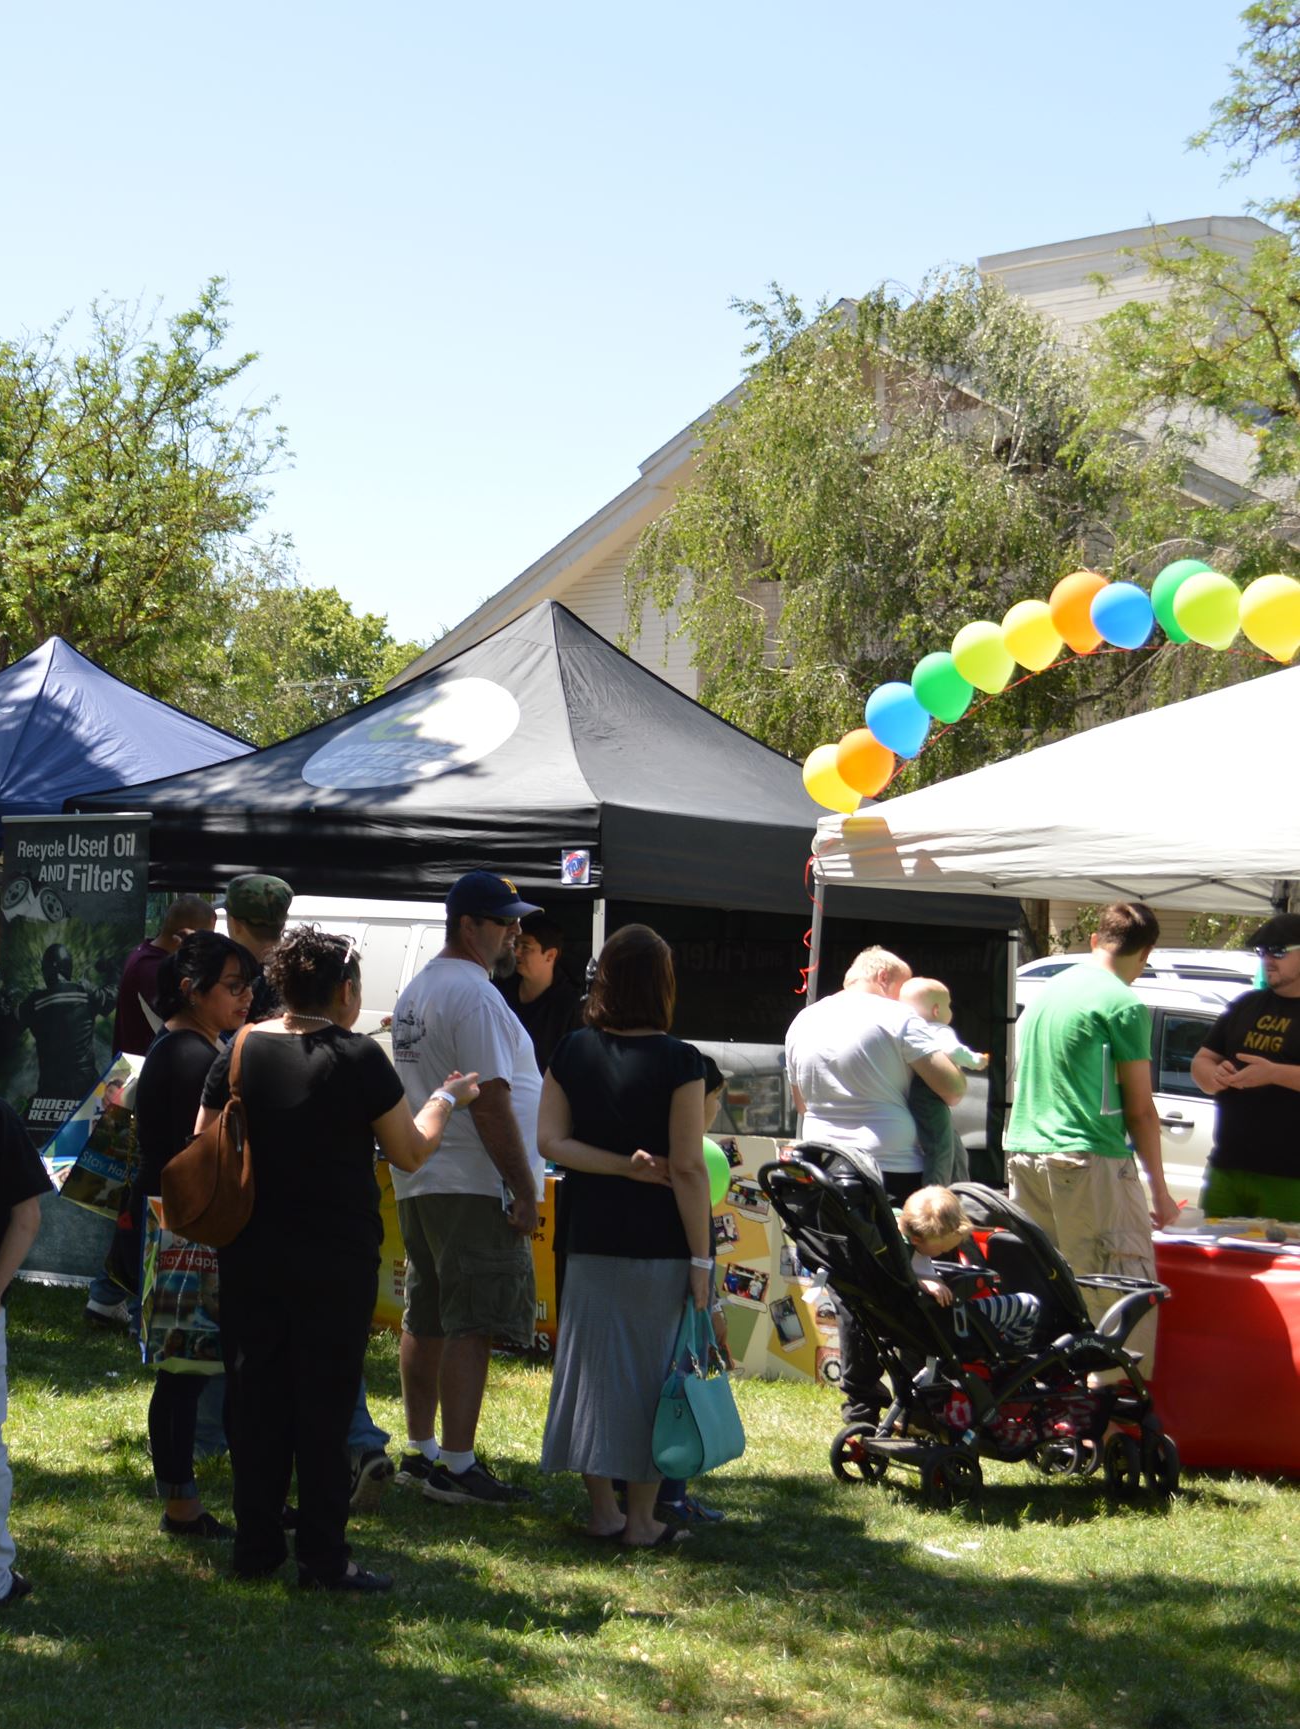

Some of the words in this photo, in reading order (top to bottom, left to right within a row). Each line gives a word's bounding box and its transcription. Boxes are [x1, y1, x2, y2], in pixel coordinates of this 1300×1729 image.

[17, 840, 65, 862] Recycle
[67, 834, 108, 858] Used
[113, 832, 136, 857] Oil
[39, 864, 65, 882] AND
[67, 863, 134, 893] Filters
[1256, 1015, 1292, 1033] CAN
[1243, 1031, 1284, 1052] KING
[81, 1151, 107, 1170] Stay
[185, 1253, 218, 1269] Happ
